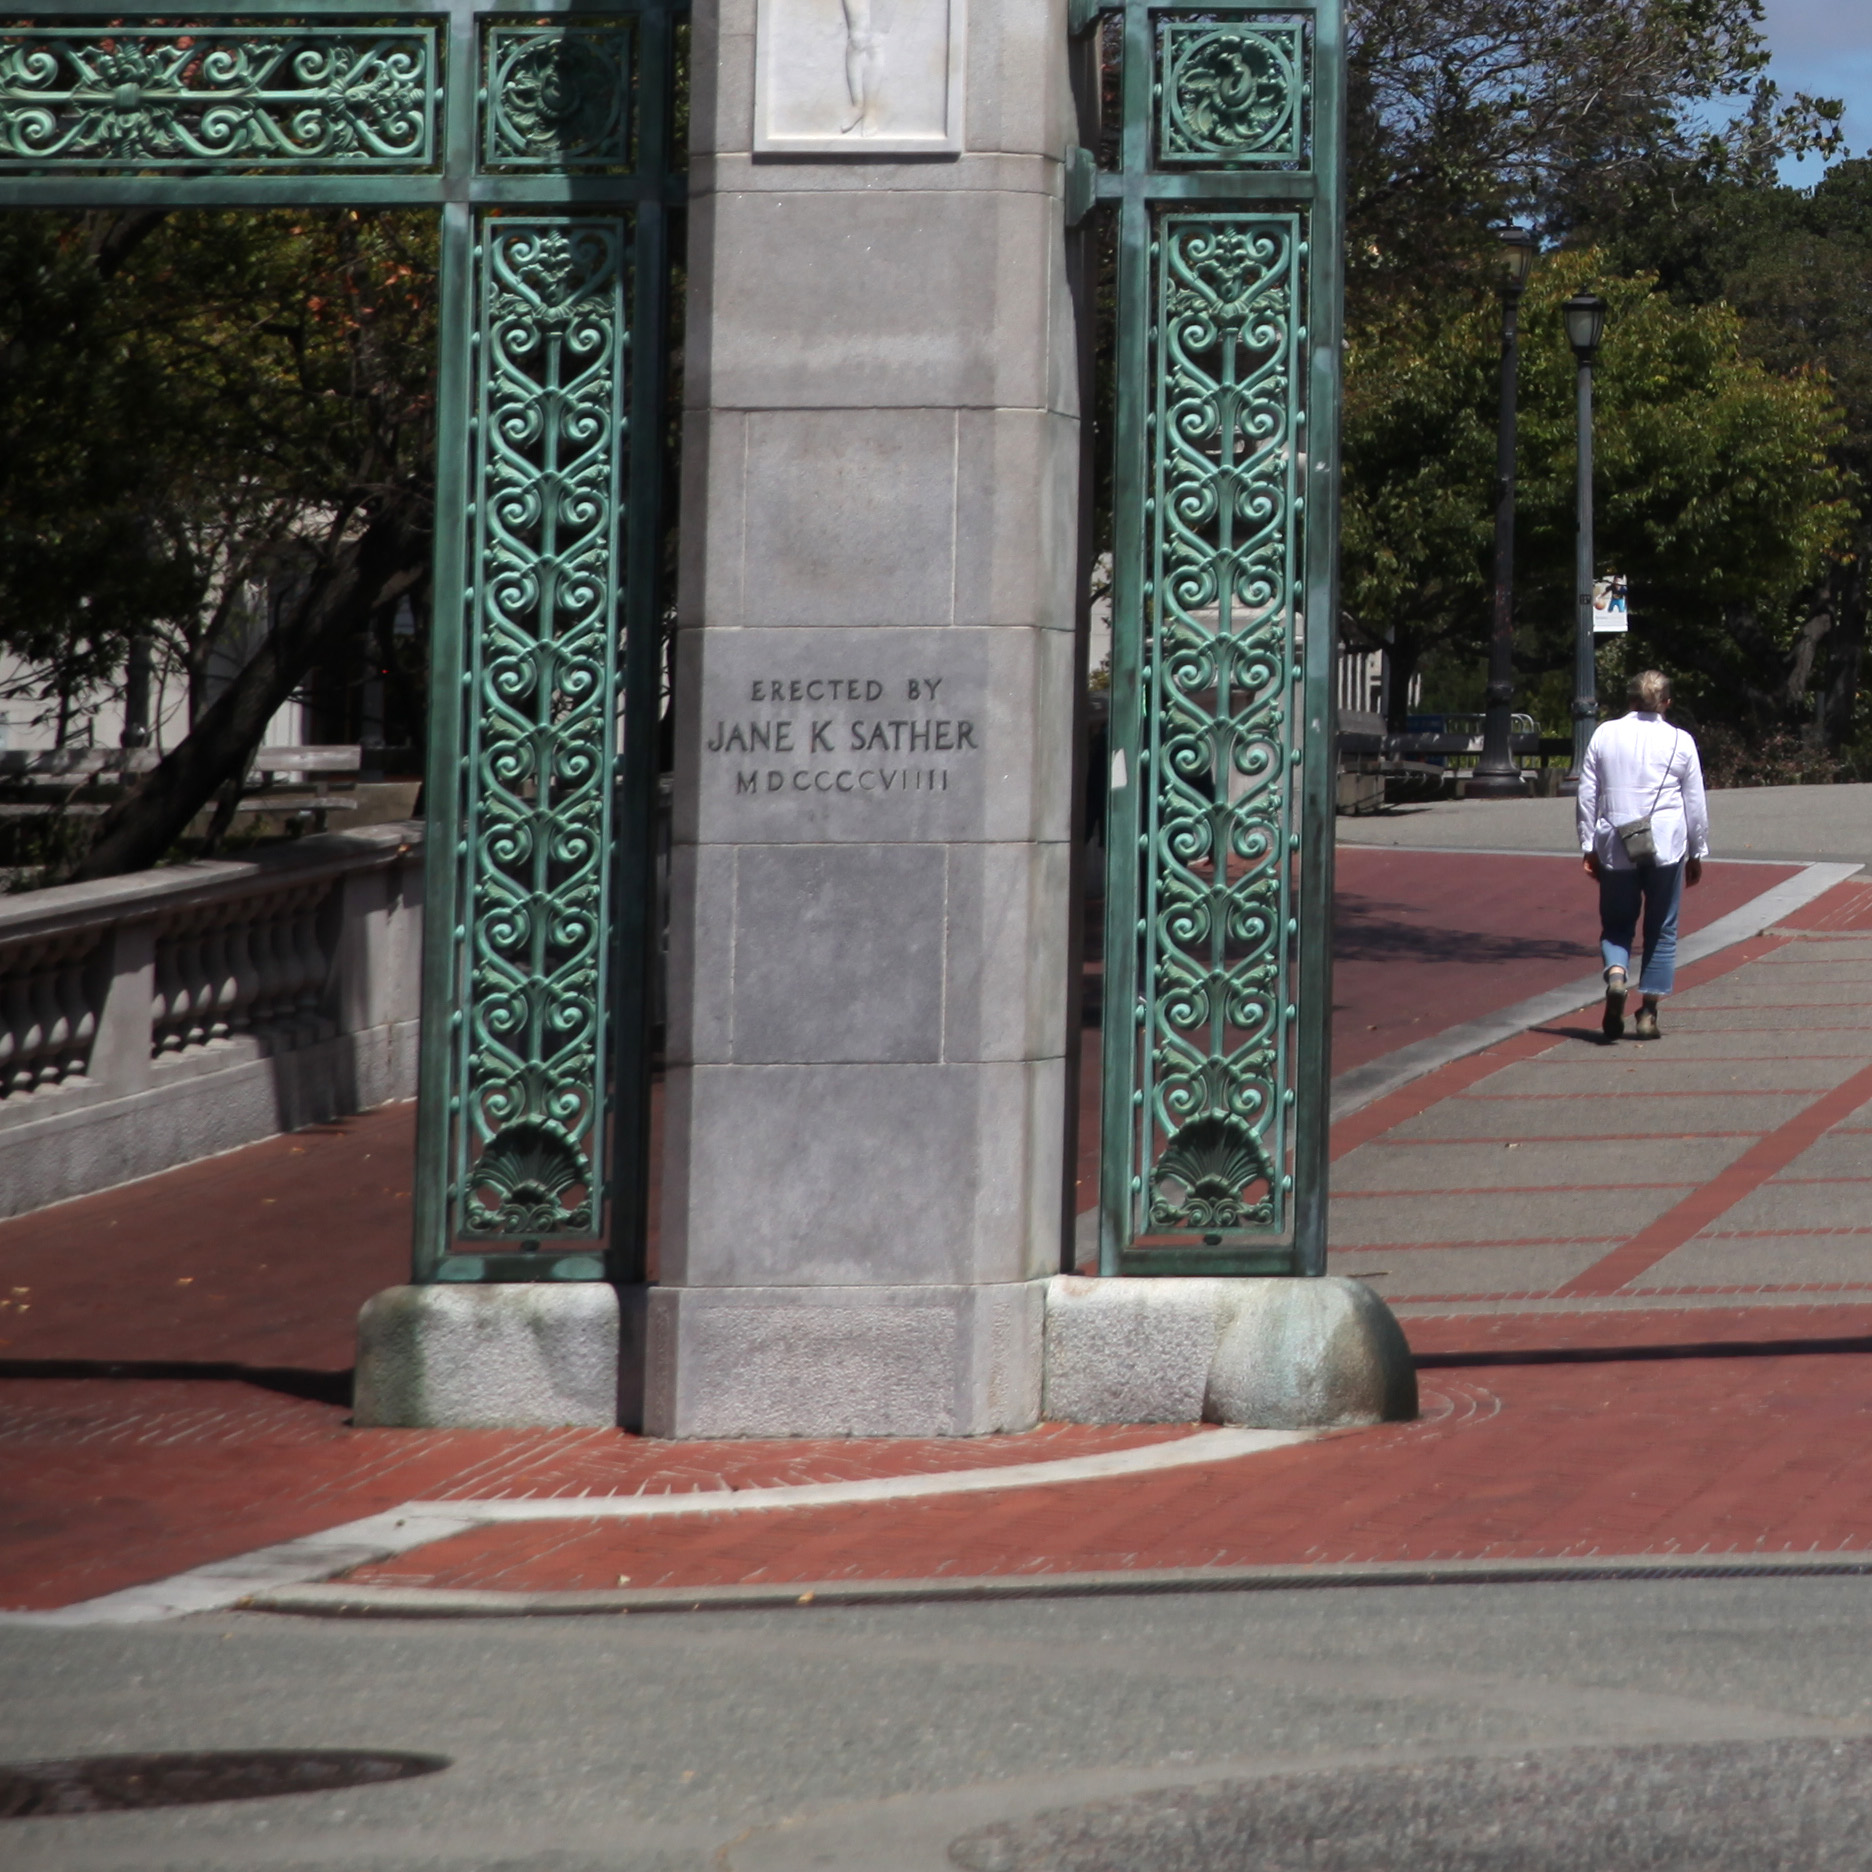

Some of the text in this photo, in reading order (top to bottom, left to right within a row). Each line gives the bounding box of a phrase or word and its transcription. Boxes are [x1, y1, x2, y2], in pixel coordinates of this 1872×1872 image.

[750, 678, 943, 701] ERECTED BY
[707, 719, 980, 753] JANE K SATHER
